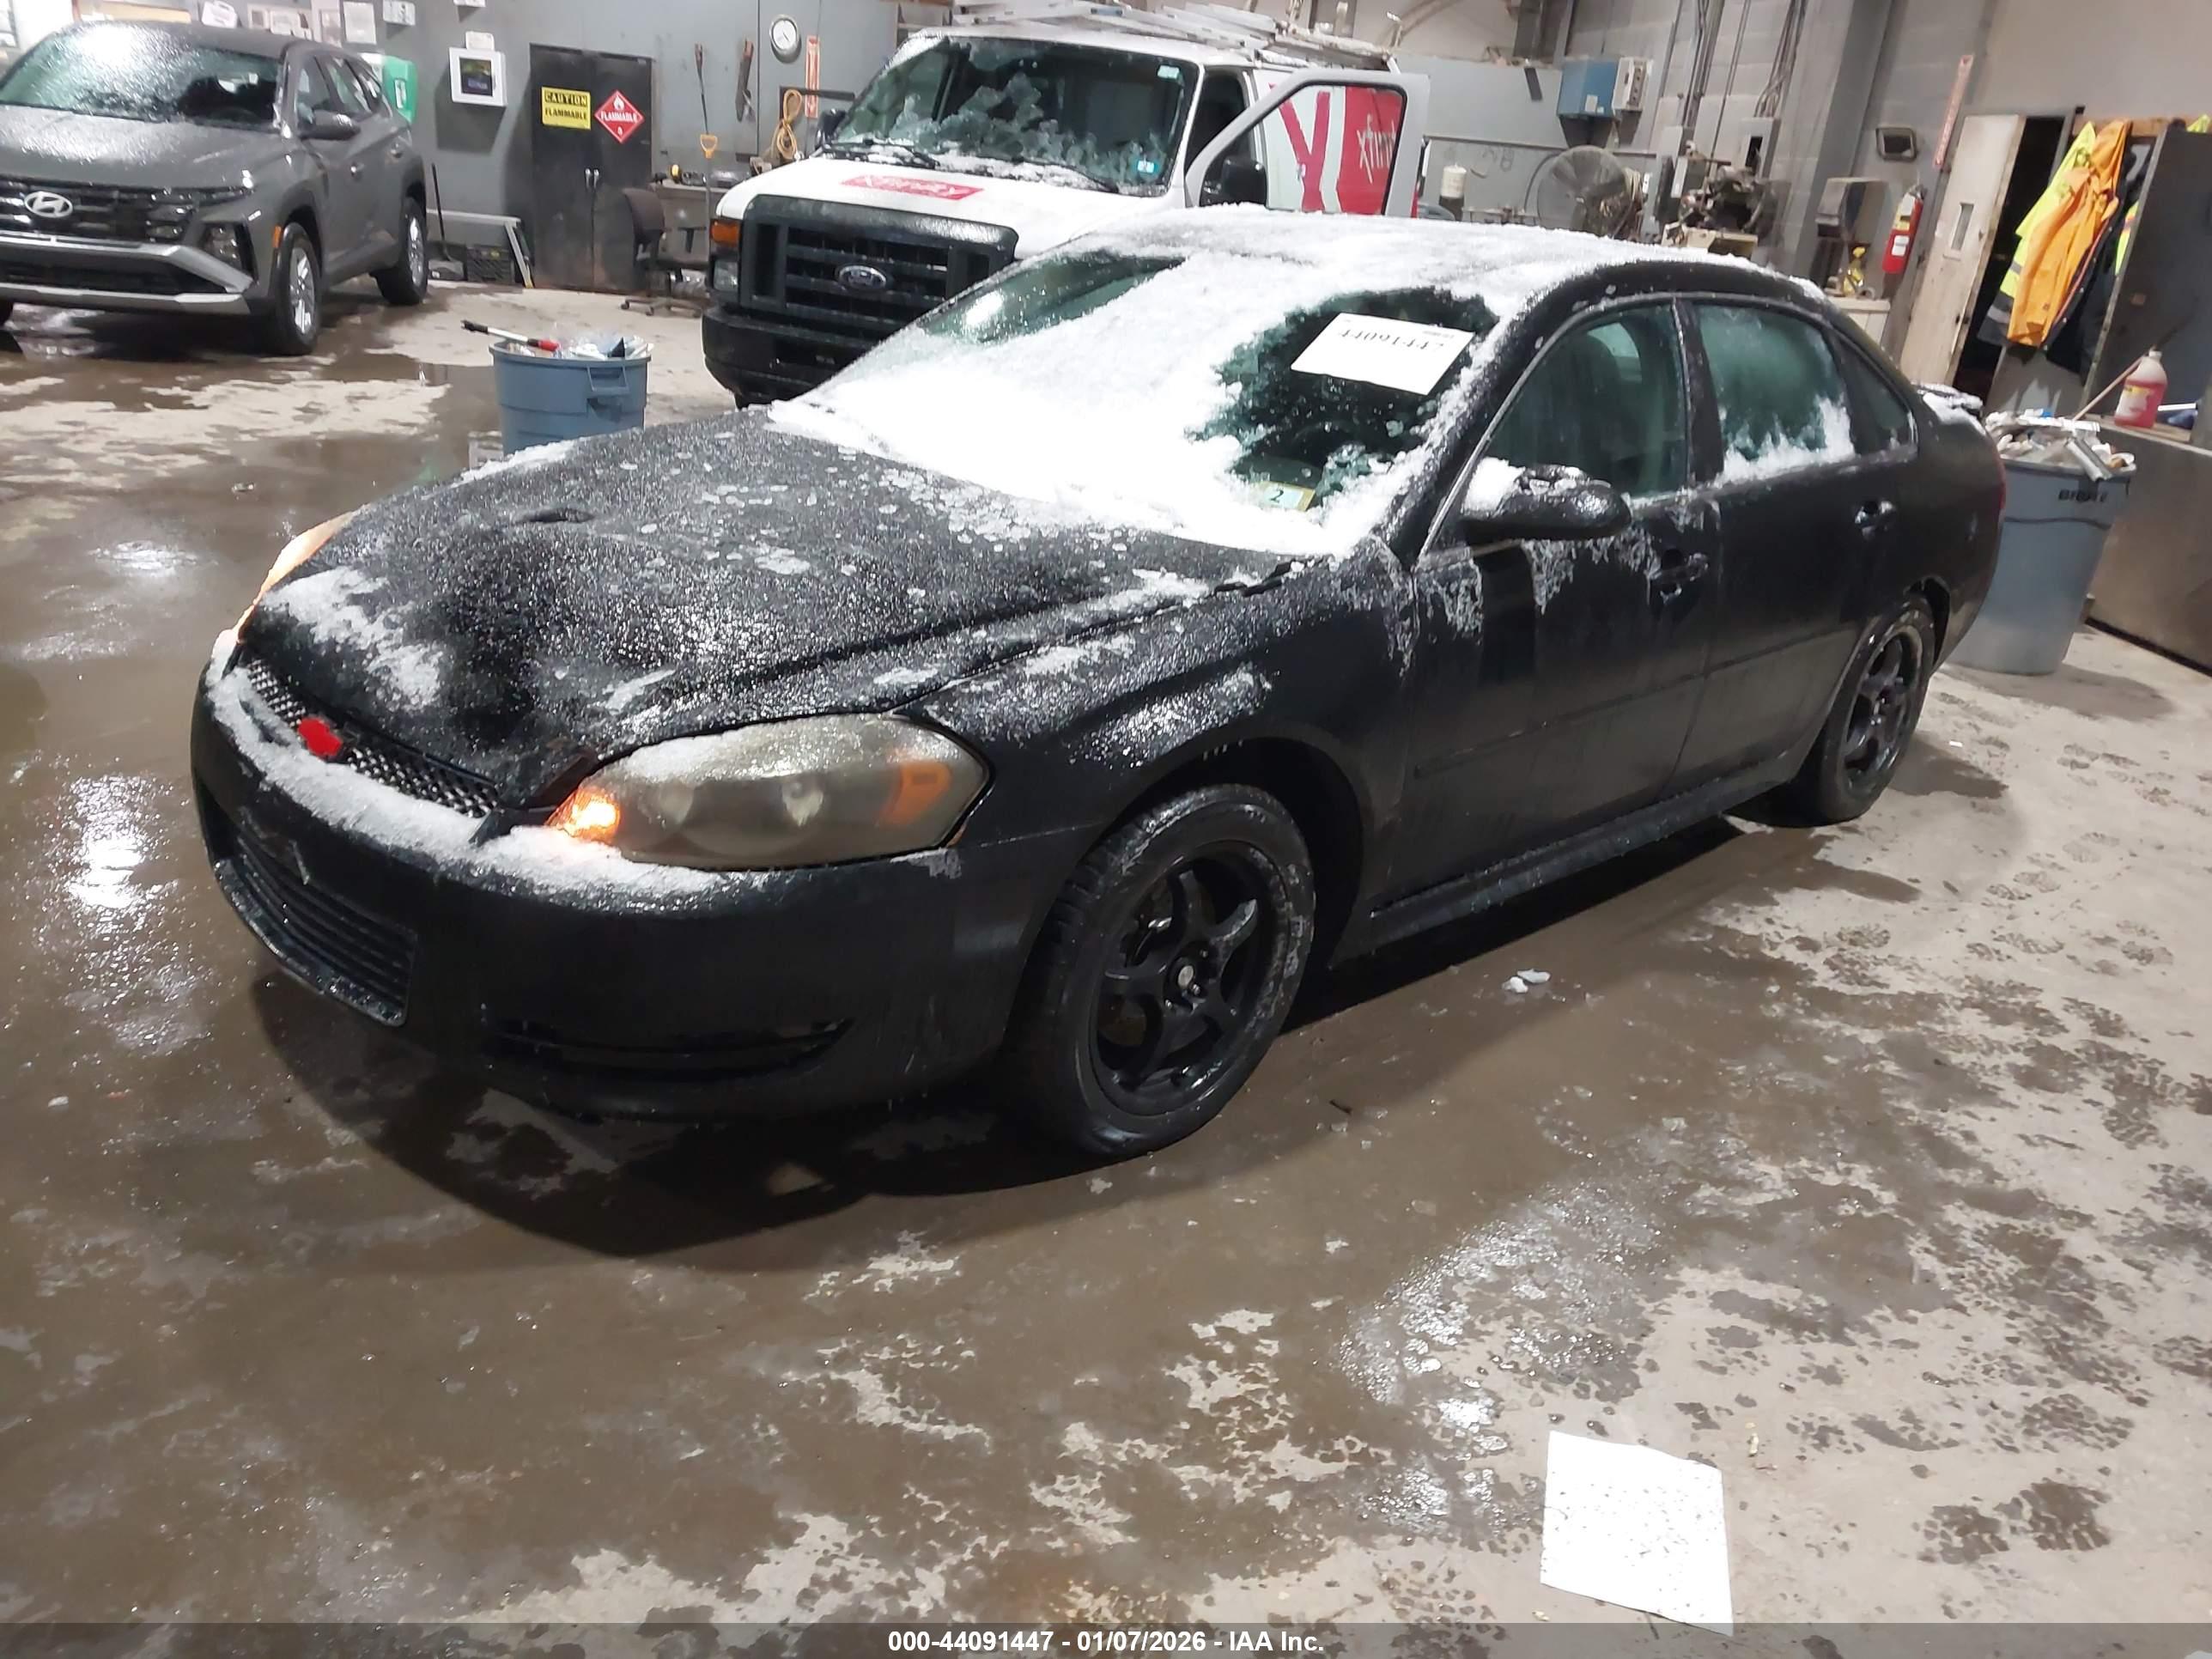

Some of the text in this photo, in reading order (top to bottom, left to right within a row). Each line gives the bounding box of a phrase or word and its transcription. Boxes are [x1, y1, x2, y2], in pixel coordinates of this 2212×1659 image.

[544, 90, 587, 107] CAUTION
[544, 107, 587, 120] FLAMMABLE
[600, 111, 638, 123] FLAMMABLE
